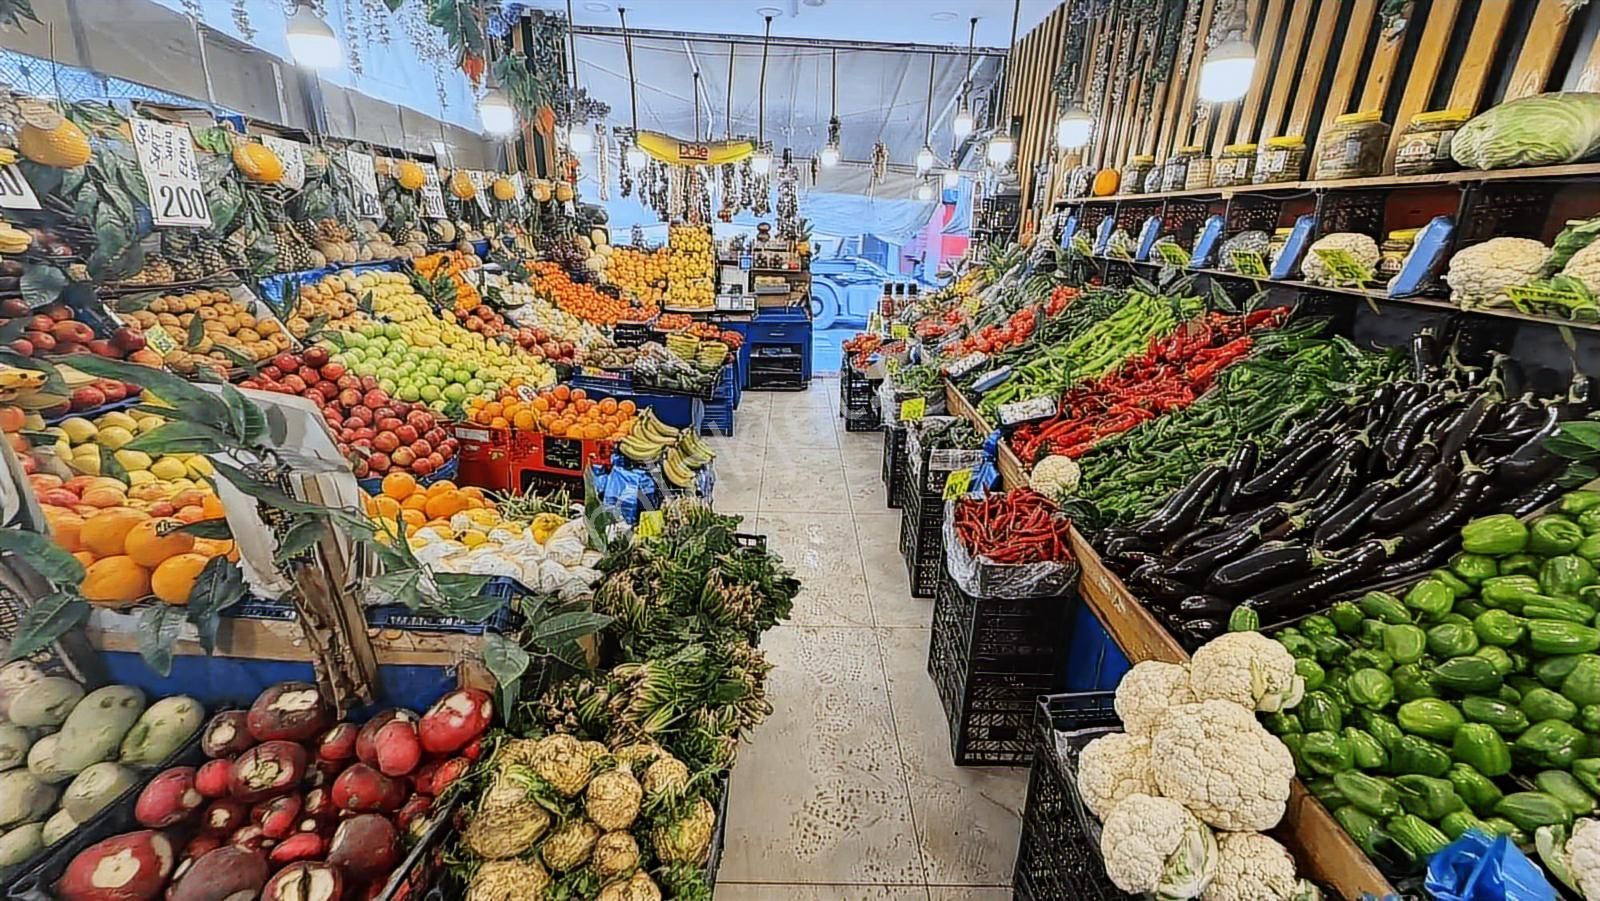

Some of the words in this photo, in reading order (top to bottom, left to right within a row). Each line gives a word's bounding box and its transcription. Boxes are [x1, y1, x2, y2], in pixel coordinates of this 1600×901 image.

[179, 137, 189, 178] ELMA
[679, 143, 708, 157] Dole
[160, 185, 206, 219] 200
